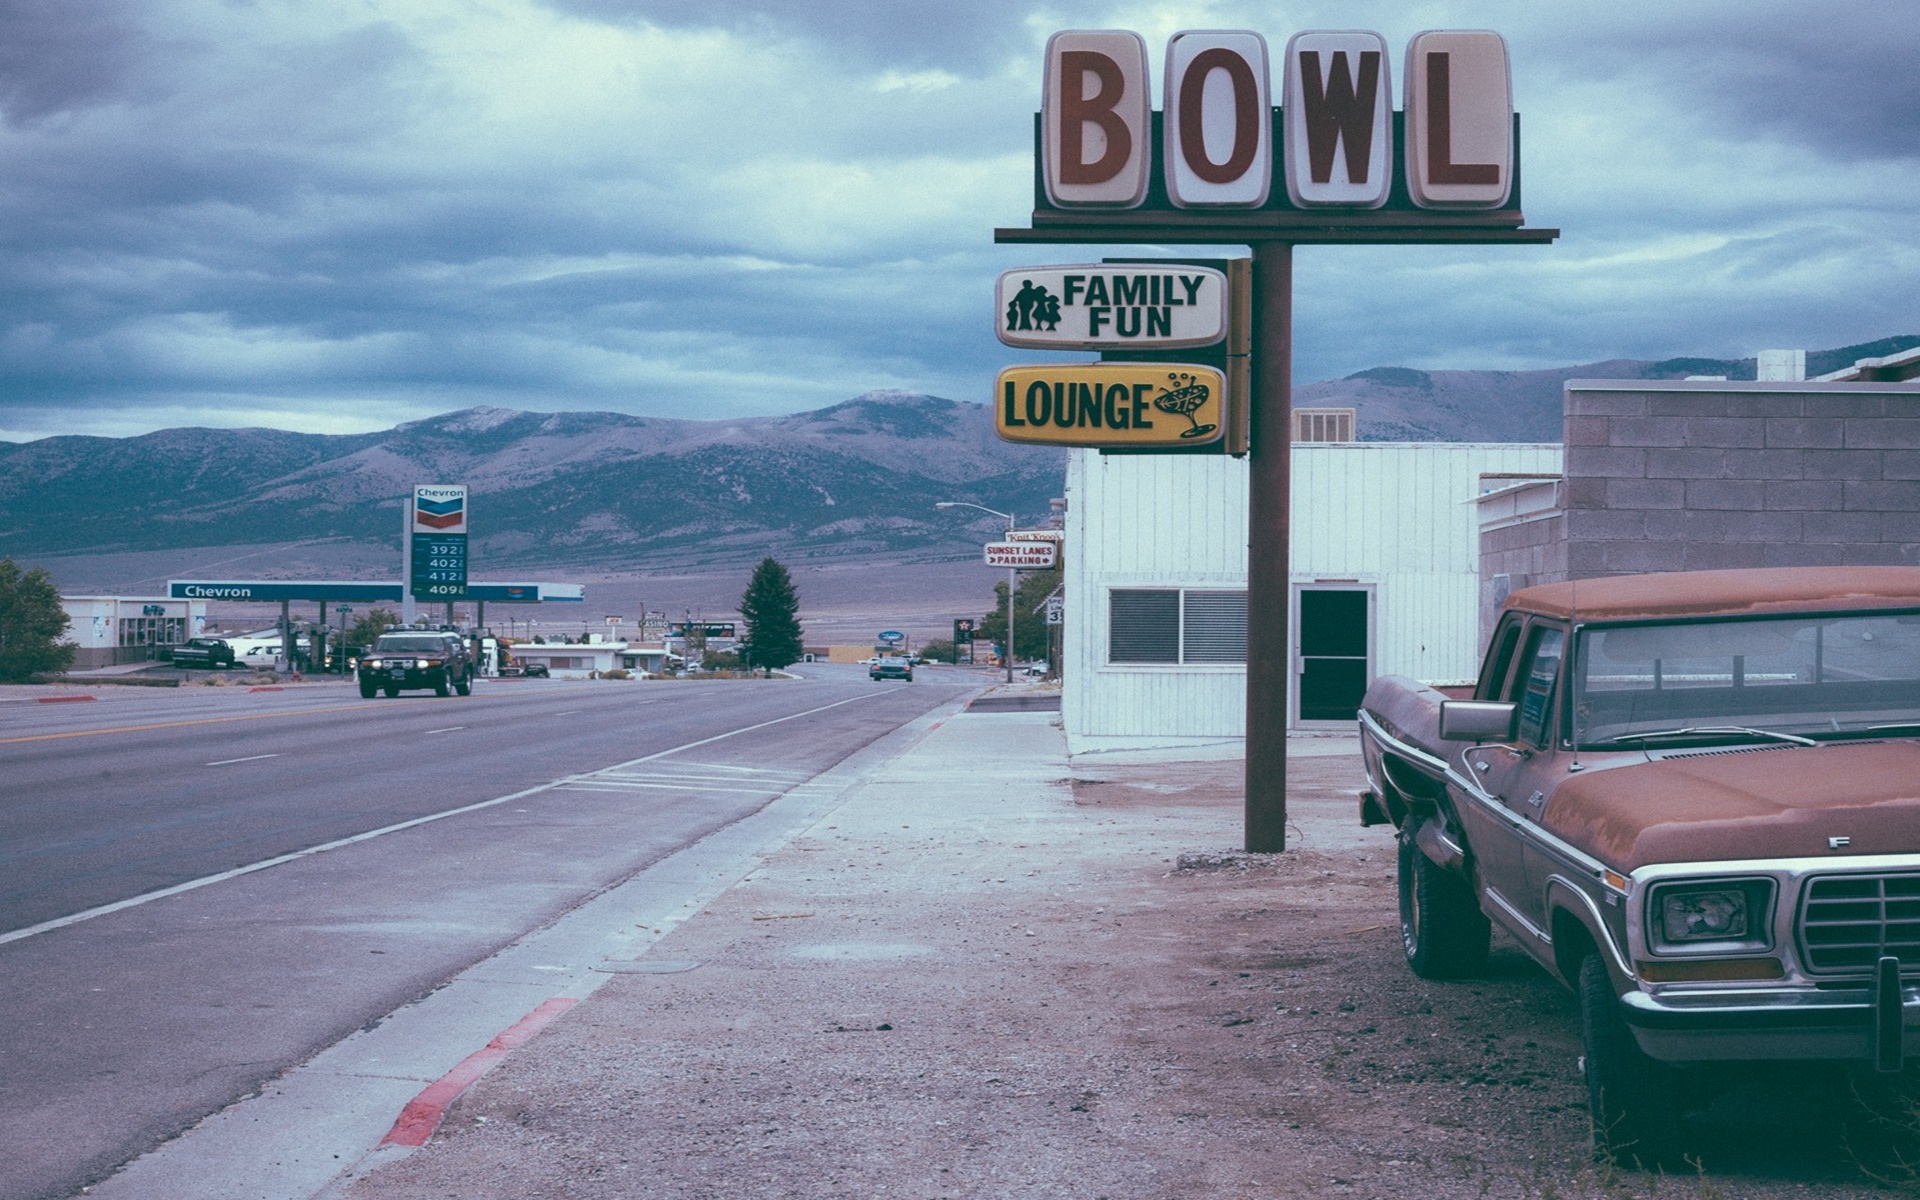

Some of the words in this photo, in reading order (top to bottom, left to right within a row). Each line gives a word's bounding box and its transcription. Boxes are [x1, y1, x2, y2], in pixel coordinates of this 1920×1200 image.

[1060, 47, 1500, 185] BOWL
[1063, 275, 1206, 306] FAMILY
[1089, 306, 1172, 337] FUN
[1005, 380, 1154, 430] LOUNGE
[417, 488, 464, 497] Chevron
[430, 546, 457, 554] 392
[987, 546, 1021, 555] SUNSET
[1023, 547, 1052, 555] LANES
[430, 559, 457, 568] 402
[997, 556, 1041, 564] PARKING
[429, 572, 457, 580] 412
[185, 585, 251, 597] Chevron
[429, 585, 457, 594] 409
